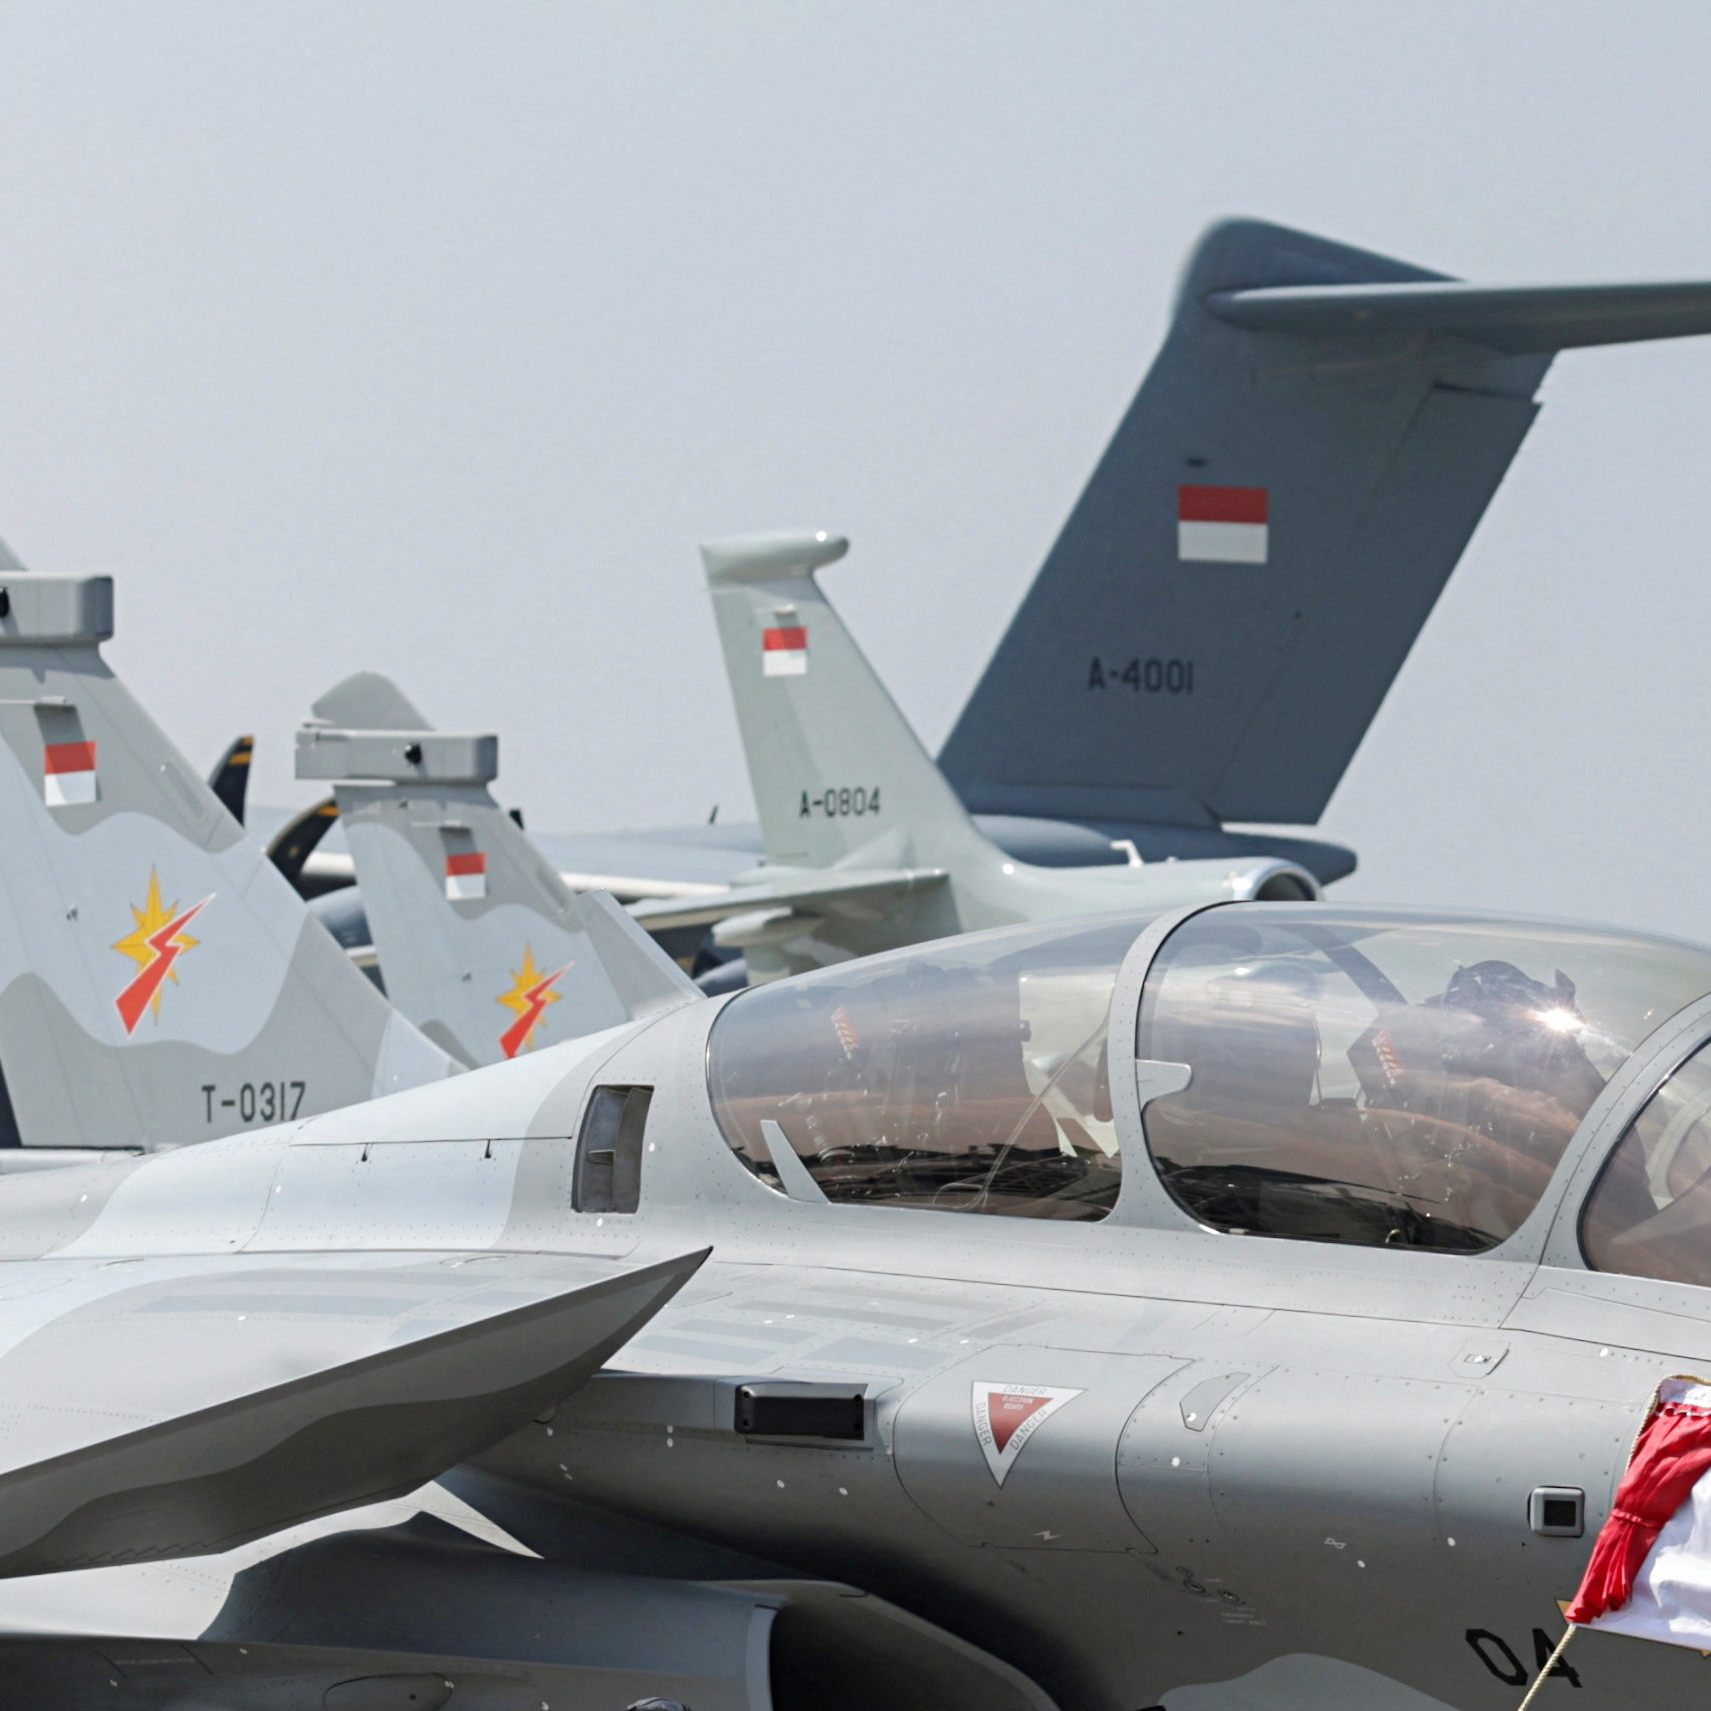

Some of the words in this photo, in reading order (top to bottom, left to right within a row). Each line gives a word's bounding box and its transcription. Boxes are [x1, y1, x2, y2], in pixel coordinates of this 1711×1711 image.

[1088, 657, 1194, 695] A-4001
[799, 786, 881, 818] A-0804
[201, 1081, 306, 1123] T-0317
[1002, 1384, 1048, 1396] DANGER
[975, 1402, 994, 1446] DANGER
[1009, 1409, 1049, 1450] DANGER
[1465, 1628, 1583, 1688] 04
